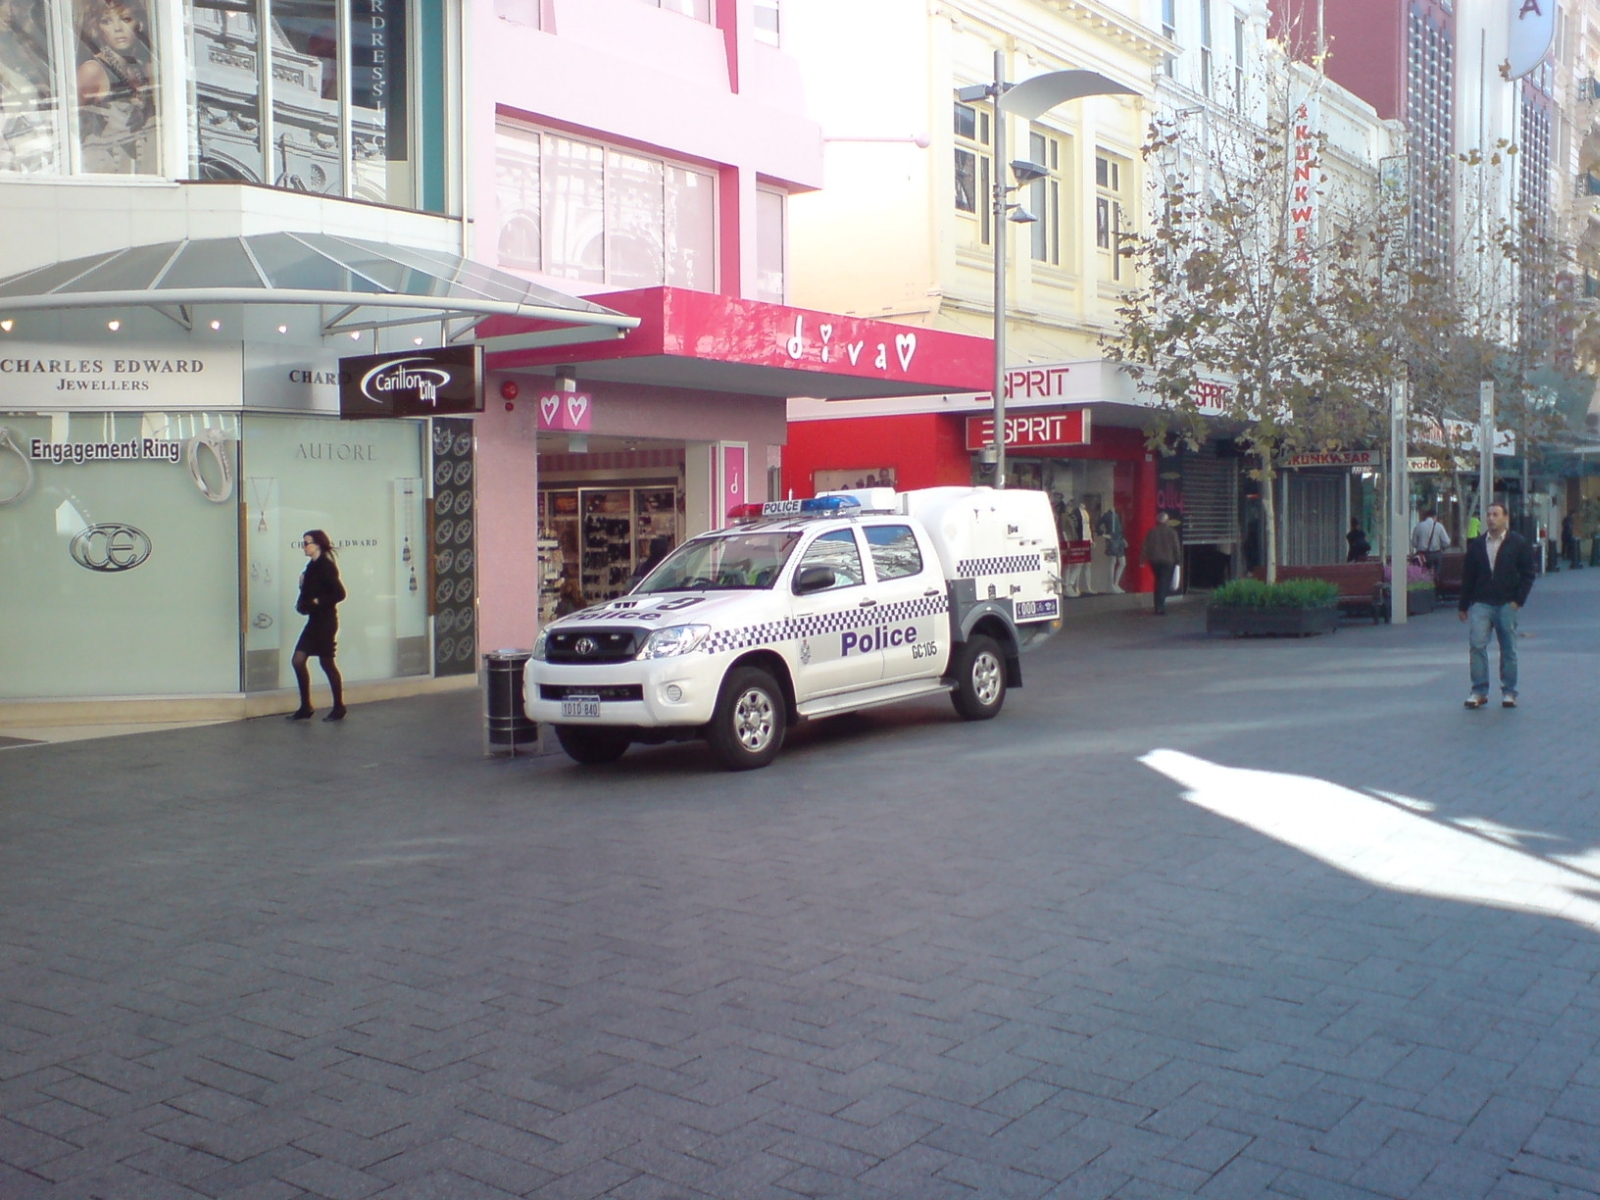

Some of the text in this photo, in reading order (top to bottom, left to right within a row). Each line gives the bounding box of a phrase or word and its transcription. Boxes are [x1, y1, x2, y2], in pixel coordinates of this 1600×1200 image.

[786, 314, 887, 371] diva
[0, 358, 205, 373] CHARLES EDWARD
[289, 369, 339, 386] CHAR
[375, 364, 422, 391] Carillon
[419, 380, 437, 407] City
[982, 415, 1068, 444] ESPRIT
[31, 437, 180, 463] Engagement Ring
[296, 443, 379, 461] AUTORE
[1286, 452, 1371, 466] KUNKWEAR
[764, 501, 799, 513] POLICE
[339, 539, 378, 548] EDWARD
[841, 625, 917, 657] Police
[912, 641, 938, 660] GC105
